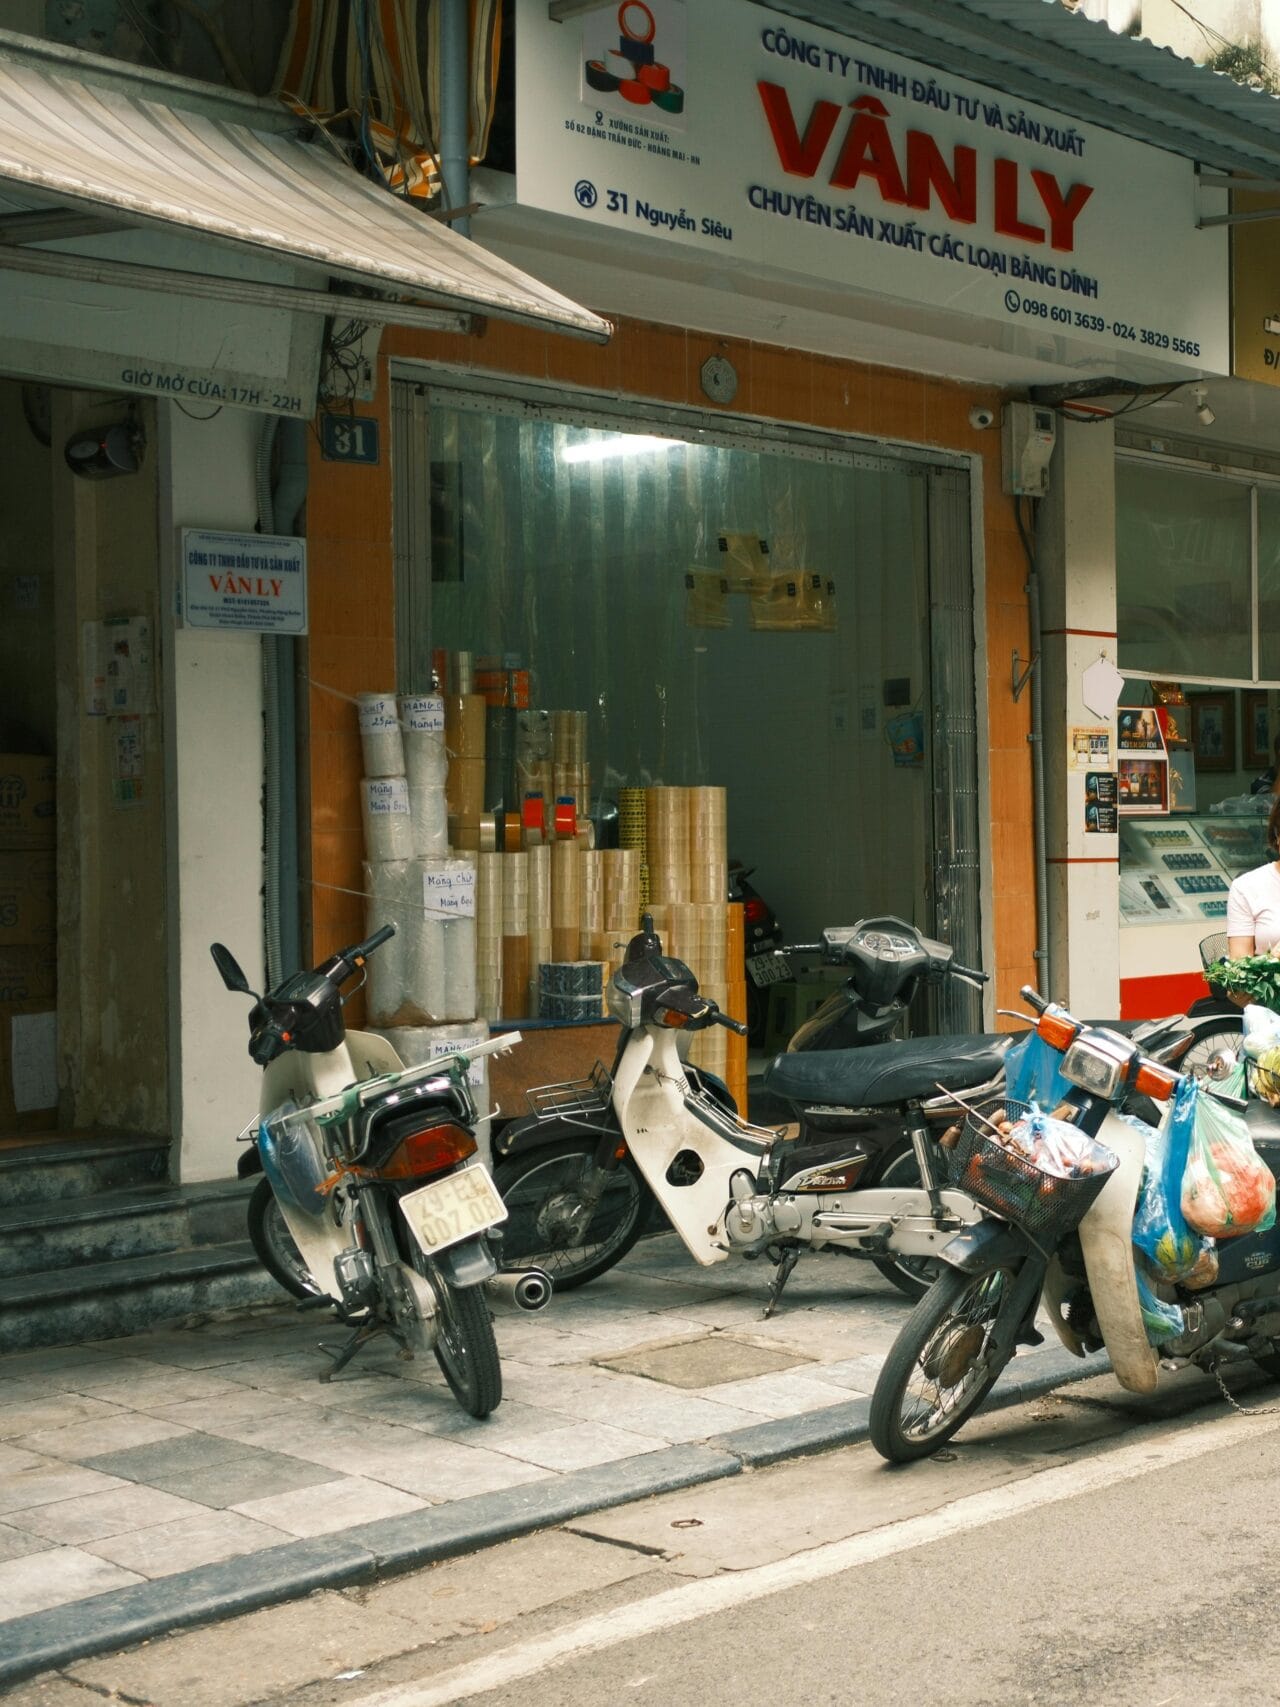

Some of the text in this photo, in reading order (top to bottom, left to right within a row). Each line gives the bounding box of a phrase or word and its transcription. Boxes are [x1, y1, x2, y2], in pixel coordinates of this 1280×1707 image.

[761, 27, 1086, 158] CÔNG TY TNHH ĐẦU TƯ VÀ SẢN XUẤT
[576, 125, 586, 134] 62
[672, 150, 686, 161] MAI
[756, 79, 1094, 253] VÂN LY
[607, 189, 732, 240] 31 Nguyễn Siêu
[747, 184, 1098, 299] CHUYÊN SẢN XUẤT CÁC LOẠI BĂNG DÍNH
[1022, 299, 1048, 318] 098
[1050, 306, 1072, 325] 601
[1139, 329, 1170, 349] 3829
[1172, 338, 1200, 357] 5565
[121, 369, 153, 387] GIỜ
[156, 374, 185, 392] MỞ
[187, 379, 227, 399] CỬA:
[230, 387, 260, 404] 17H
[272, 394, 302, 411] 22H
[335, 424, 366, 457] 31
[189, 550, 208, 566] CÔNG
[209, 553, 216, 567] TY
[218, 554, 235, 569] TNHH
[208, 571, 283, 597] VÂN LY
